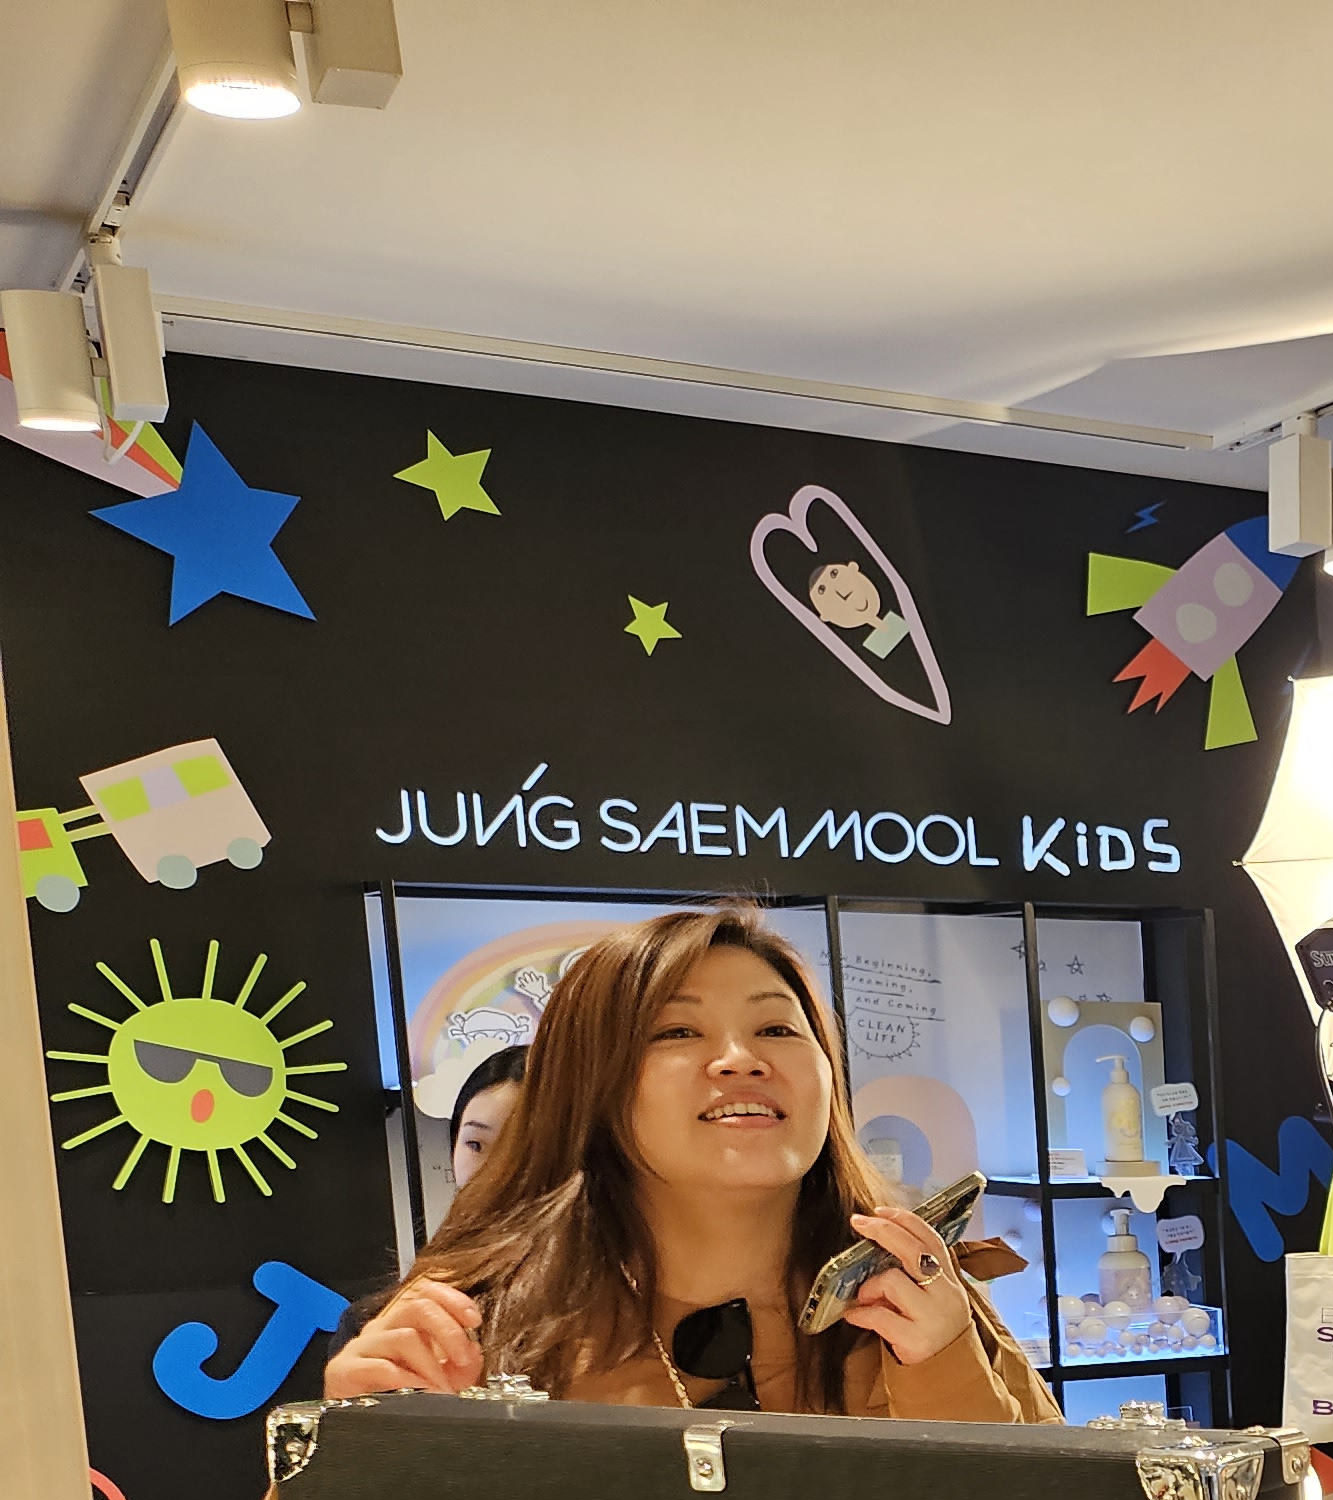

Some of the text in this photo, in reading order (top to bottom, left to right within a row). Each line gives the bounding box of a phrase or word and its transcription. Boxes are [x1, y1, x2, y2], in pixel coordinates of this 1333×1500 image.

[888, 998, 936, 1016] Coming
[857, 1019, 906, 1033] CLEAN
[866, 1033, 897, 1044] LIFE
